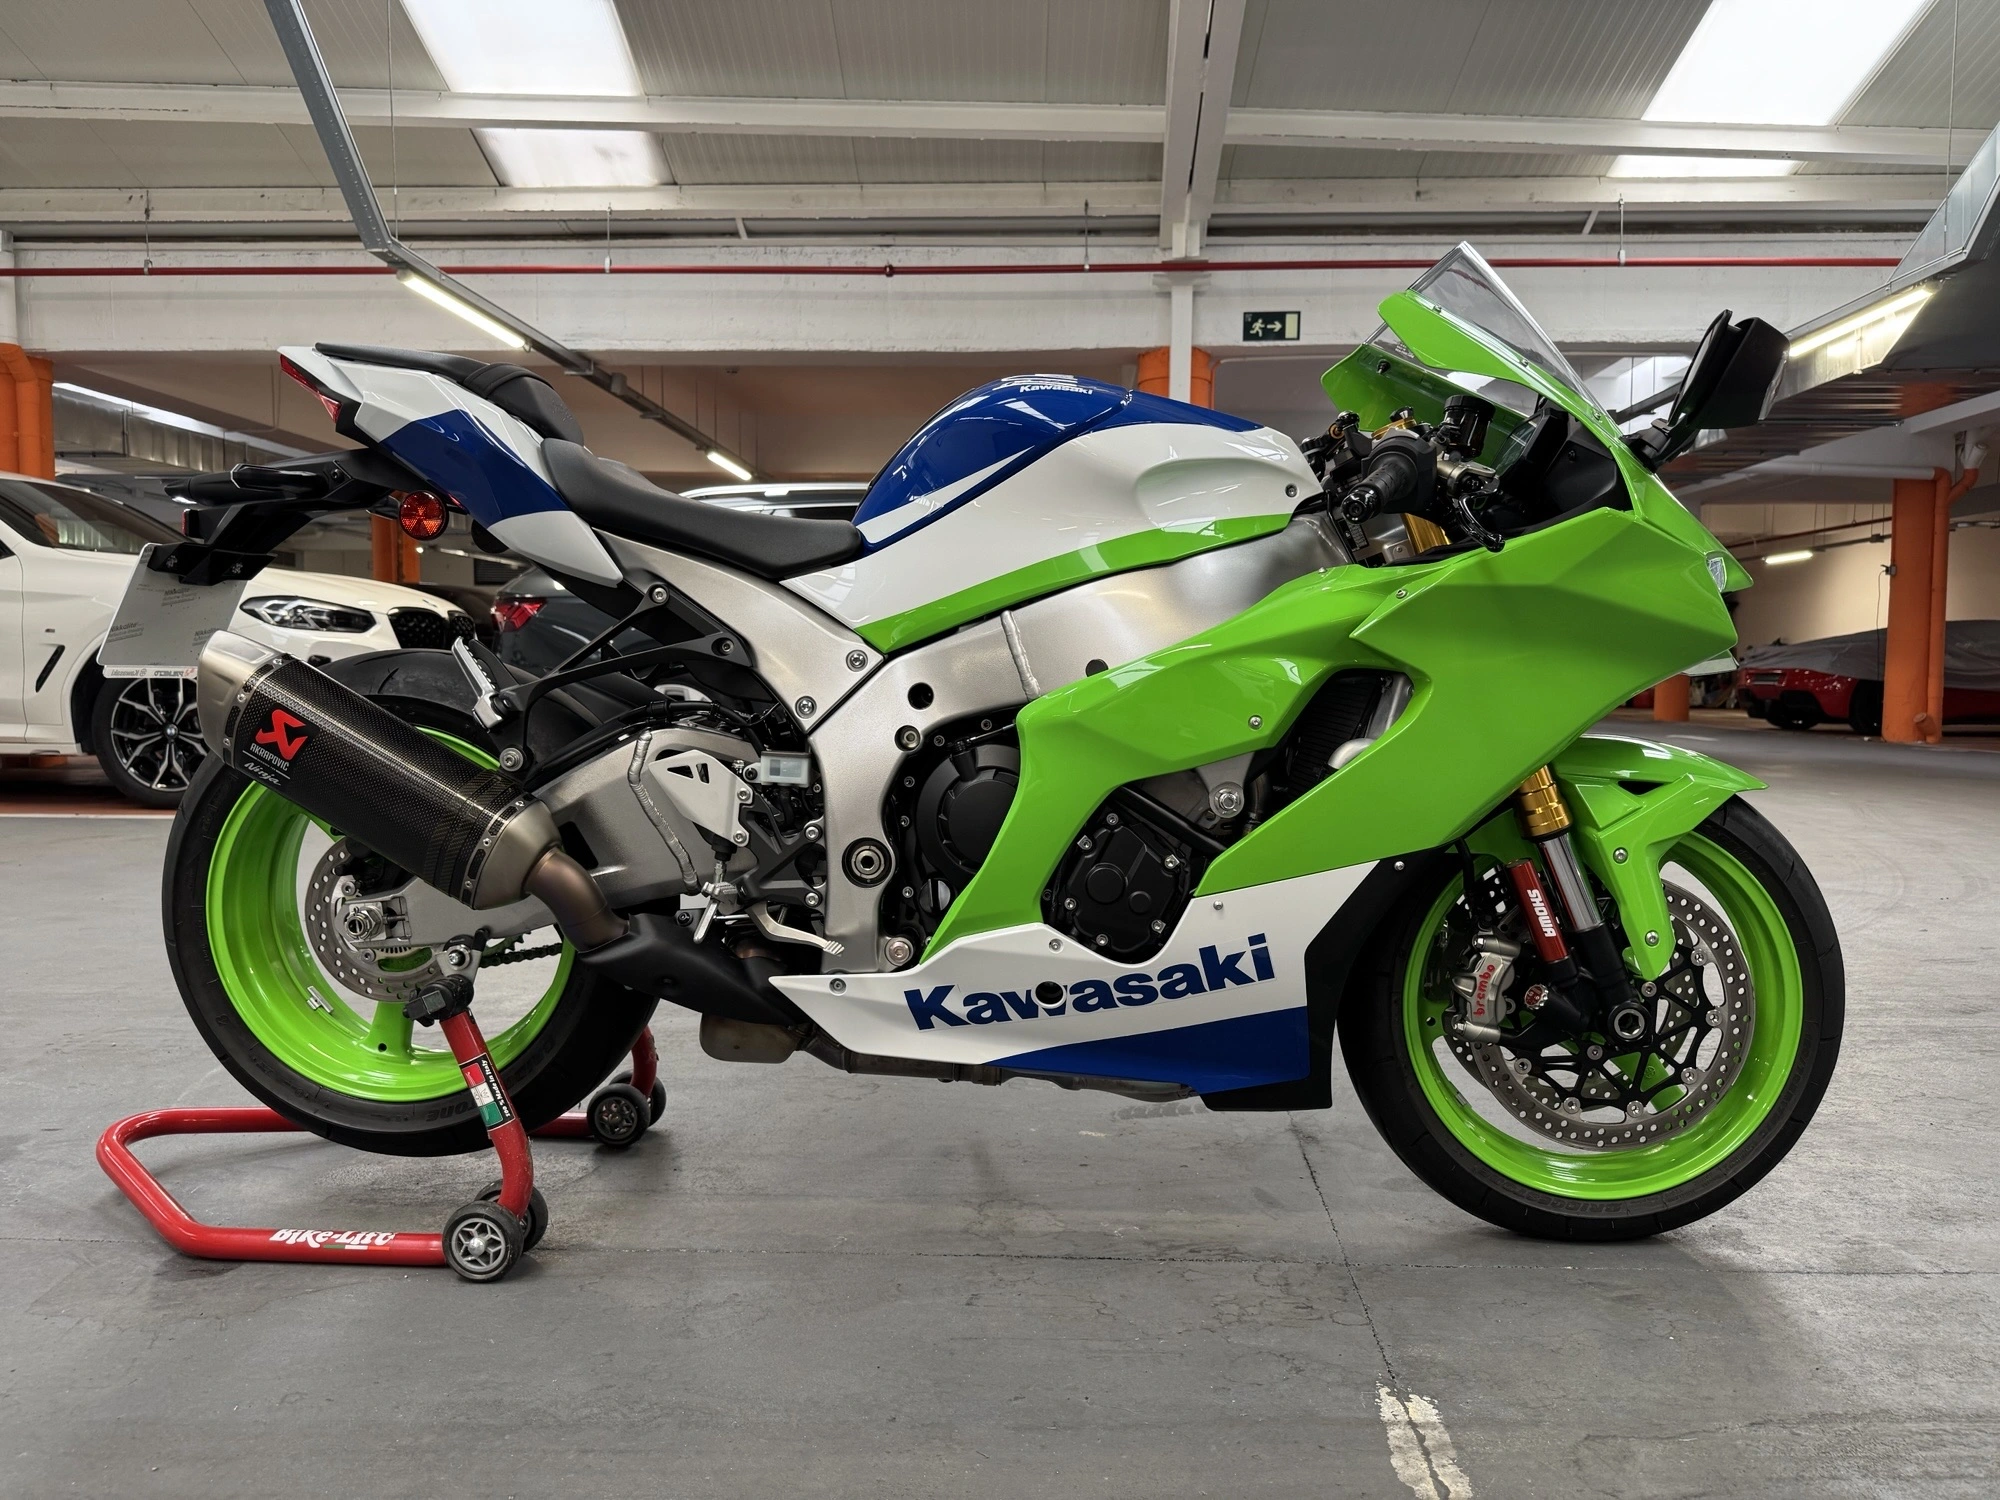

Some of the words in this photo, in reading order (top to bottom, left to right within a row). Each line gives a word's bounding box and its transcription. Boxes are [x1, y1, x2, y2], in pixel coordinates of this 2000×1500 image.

[1020, 385, 1094, 395] Kawasaki
[244, 761, 281, 786] Ninja
[1527, 889, 1557, 938] SHOWA
[904, 932, 1275, 1031] Kawasaki
[1473, 964, 1496, 1017] brembo
[482, 1060, 492, 1075] Italy
[492, 1083, 503, 1100] Made
